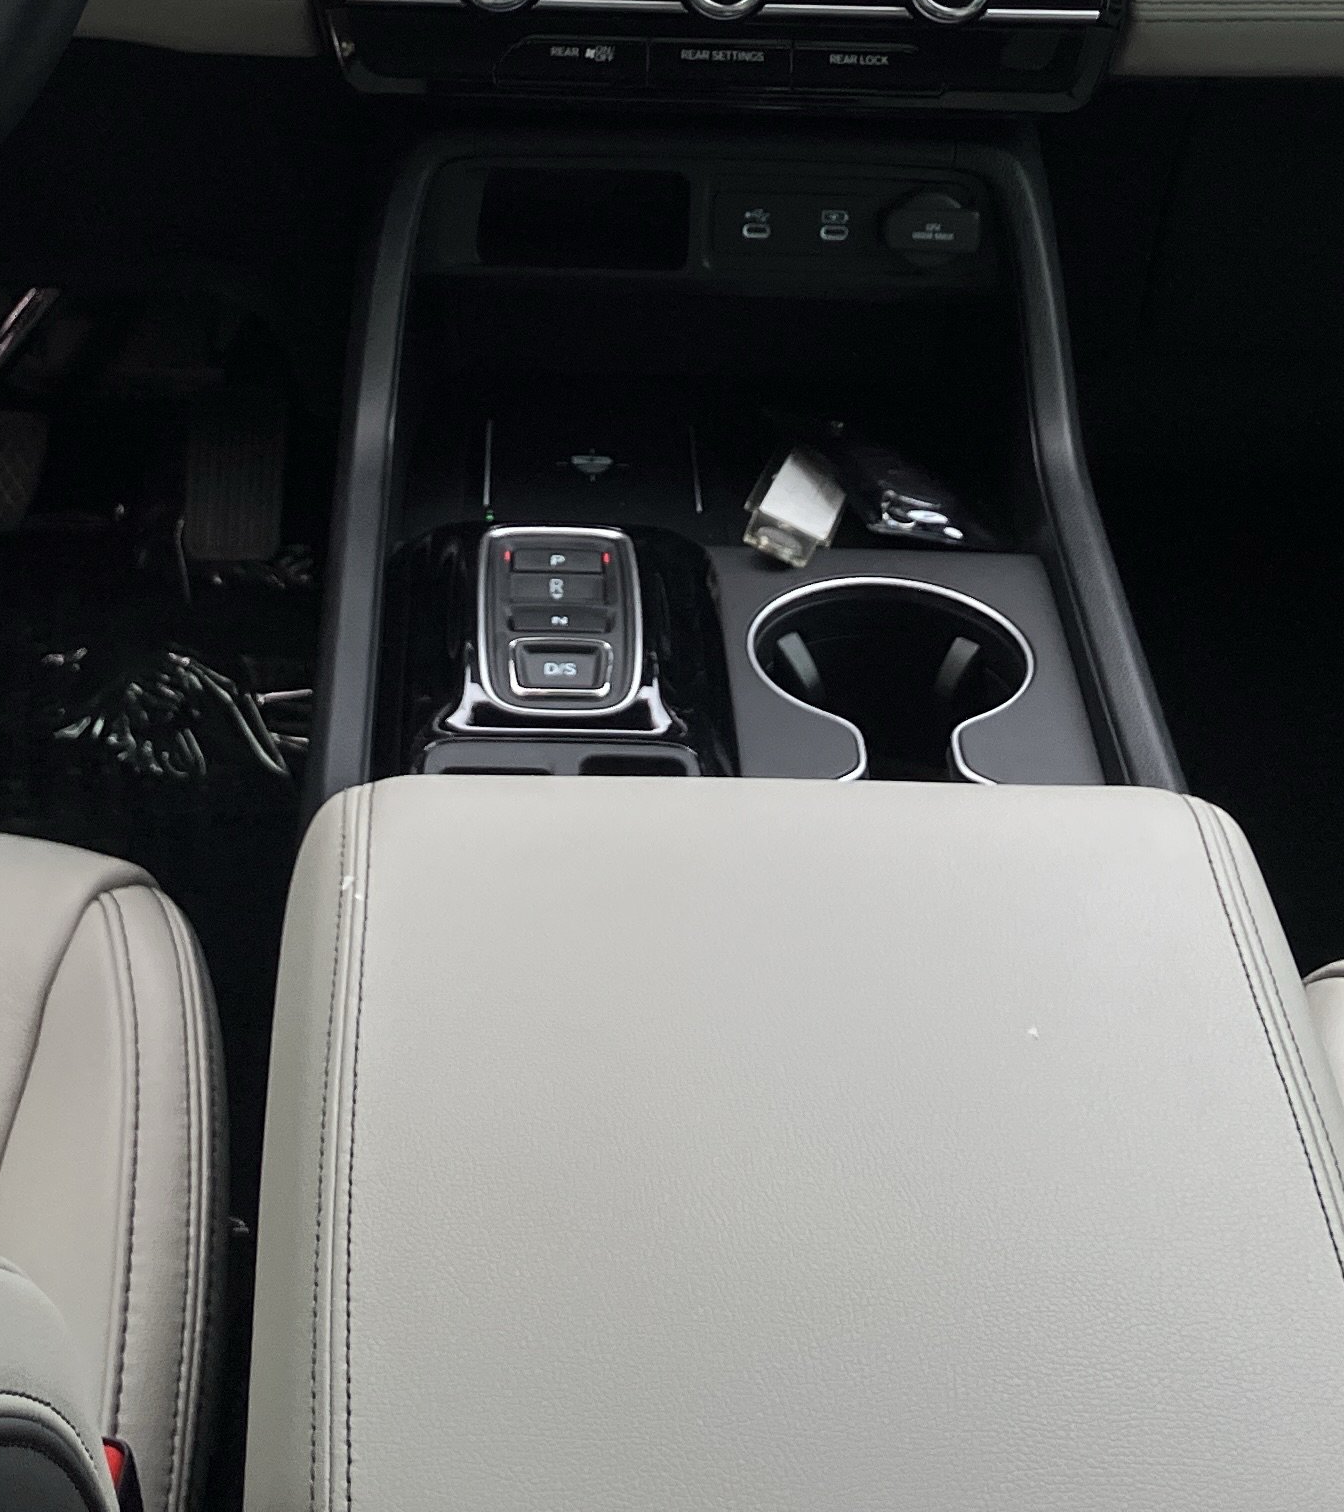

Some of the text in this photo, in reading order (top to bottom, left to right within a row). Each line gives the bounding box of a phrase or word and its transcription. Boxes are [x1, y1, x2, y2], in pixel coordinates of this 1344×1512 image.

[549, 46, 579, 59] REAR
[680, 48, 765, 63] REAR SETTINGS
[829, 53, 889, 67] REAR LOCK
[549, 553, 566, 567] P
[548, 578, 564, 594] R
[543, 661, 577, 677] D/S
